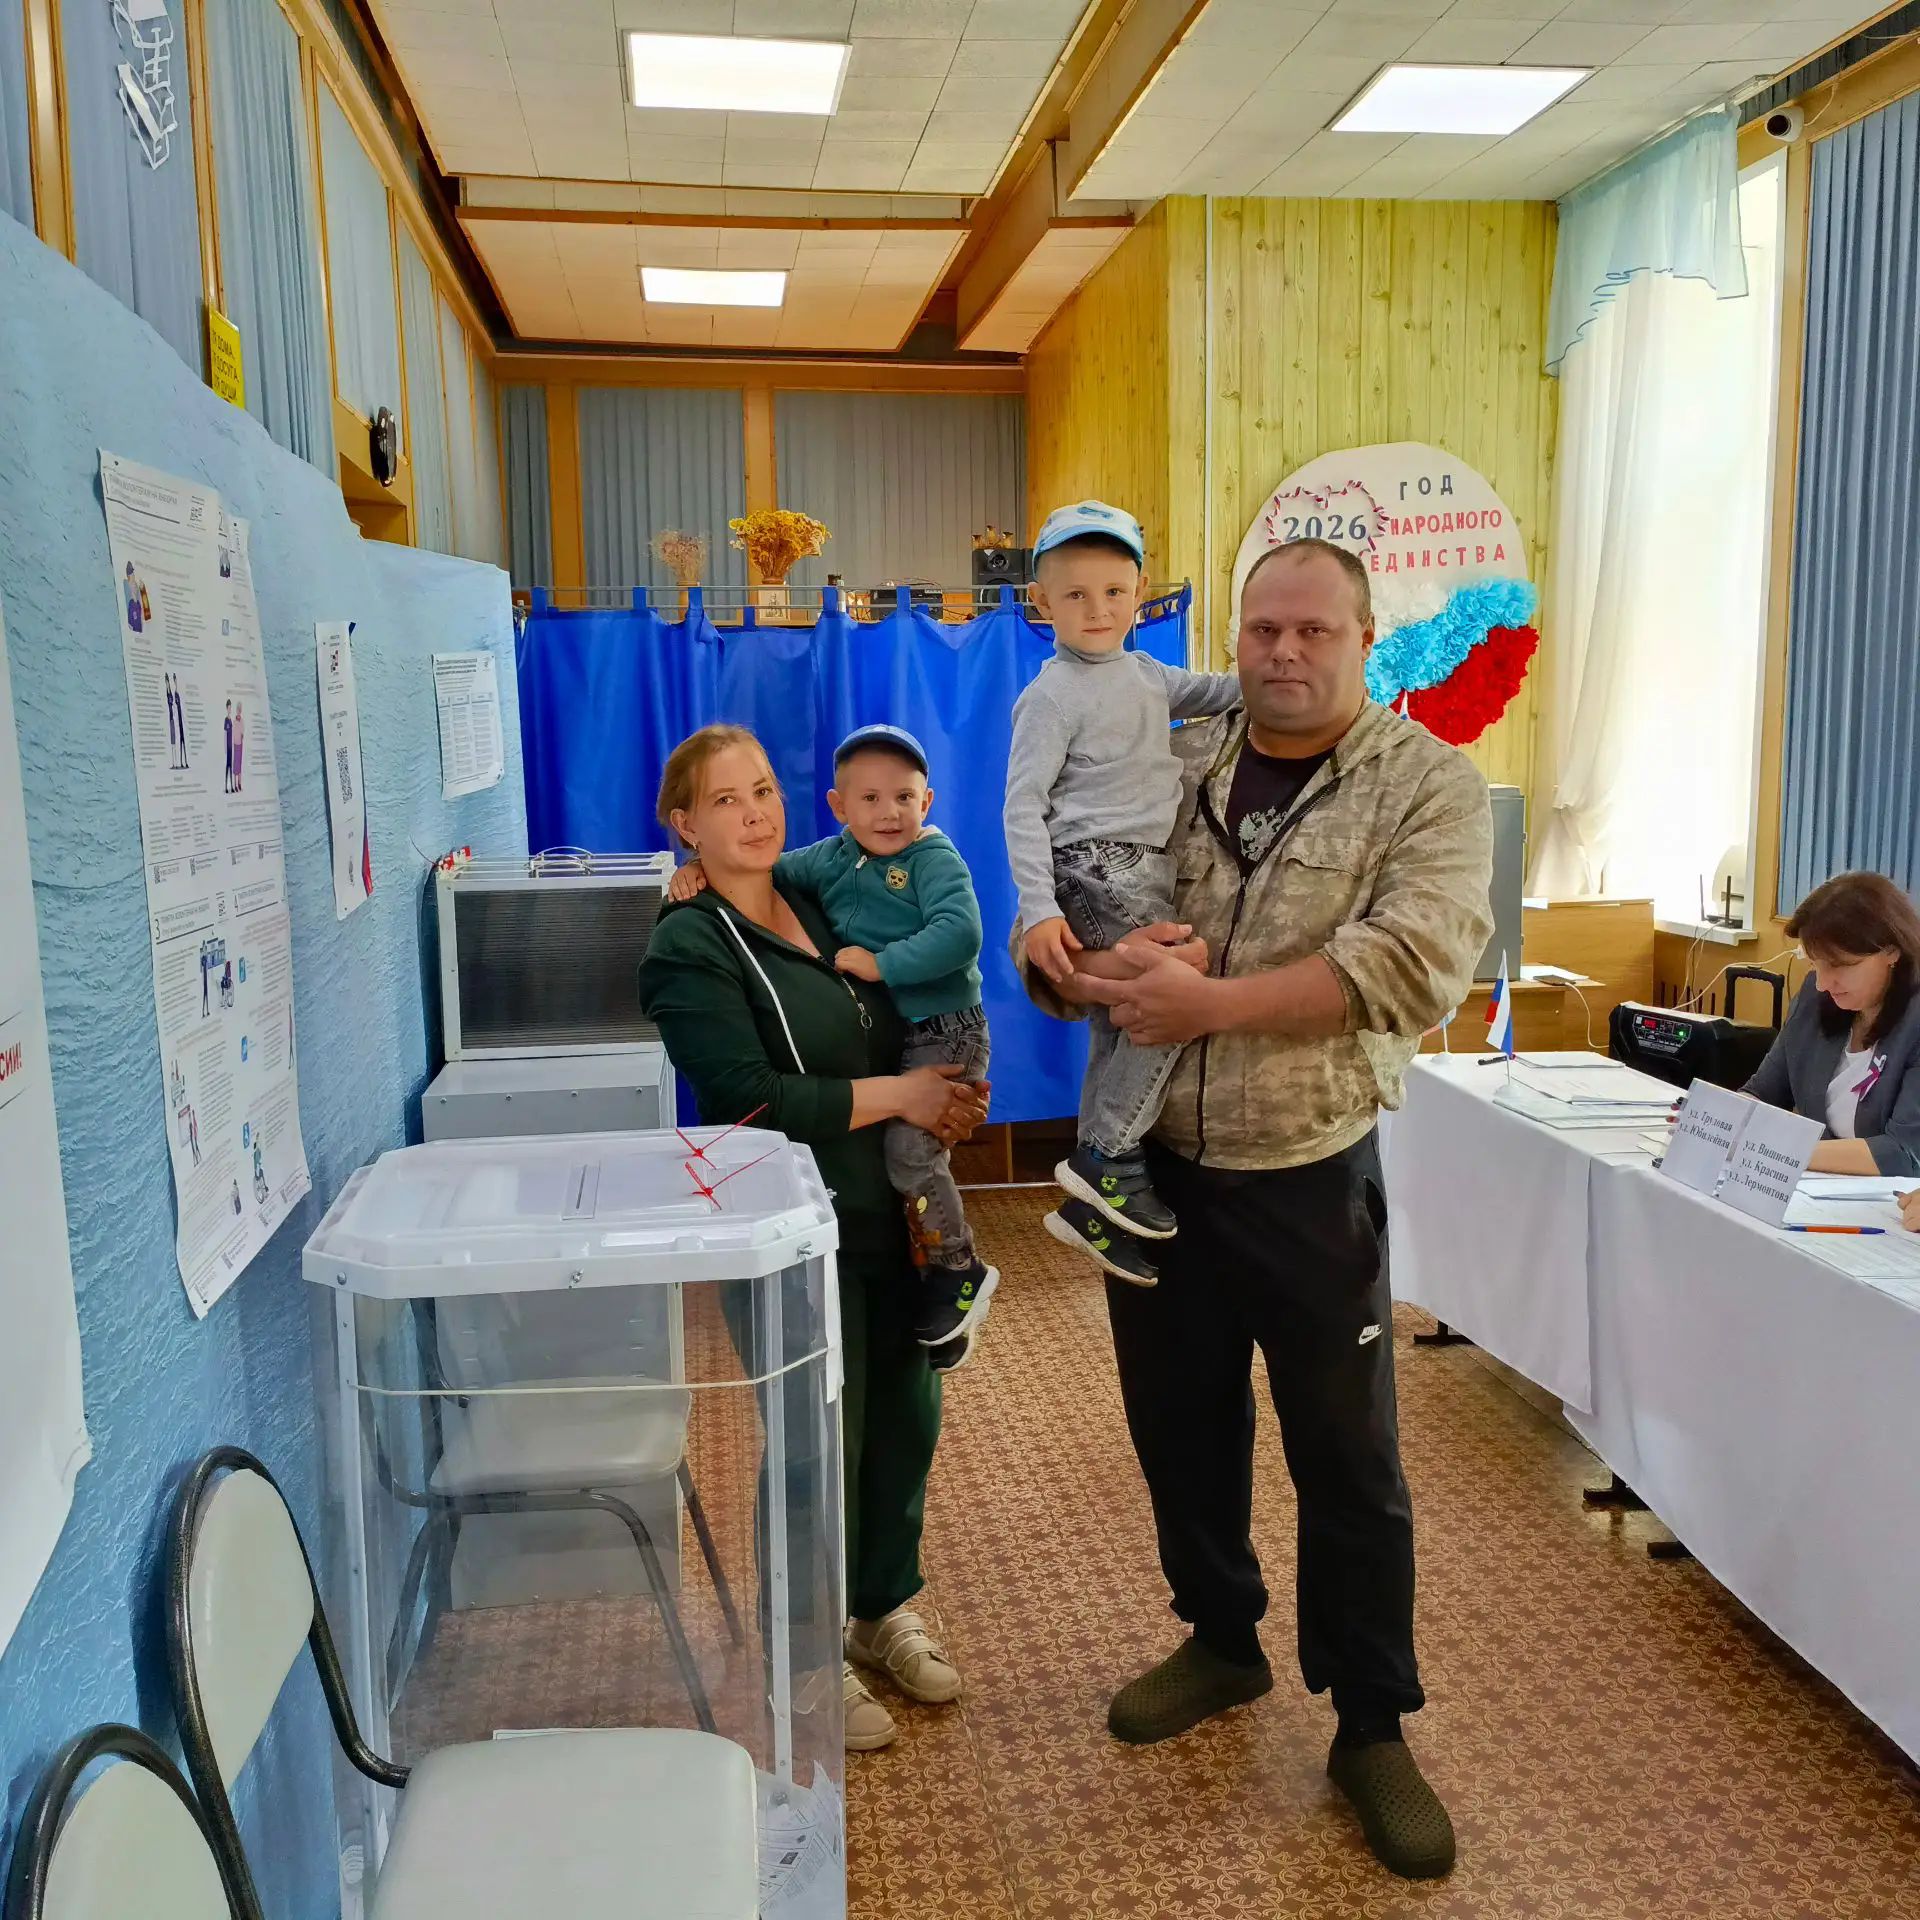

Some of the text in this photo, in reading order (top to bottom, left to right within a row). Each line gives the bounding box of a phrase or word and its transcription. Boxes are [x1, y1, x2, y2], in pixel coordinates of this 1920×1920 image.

[1400, 474, 1453, 501] ГОД
[1283, 514, 1367, 542] 2026
[1390, 509, 1502, 536] НАРОДНОГО
[1370, 543, 1506, 573] ЕДИНСТВА
[1700, 1111, 1733, 1133] Трудовая
[1690, 1125, 1731, 1150] Юбилейная
[1754, 1160, 1789, 1184] Красина
[1740, 1174, 1790, 1204] Лермонтова
